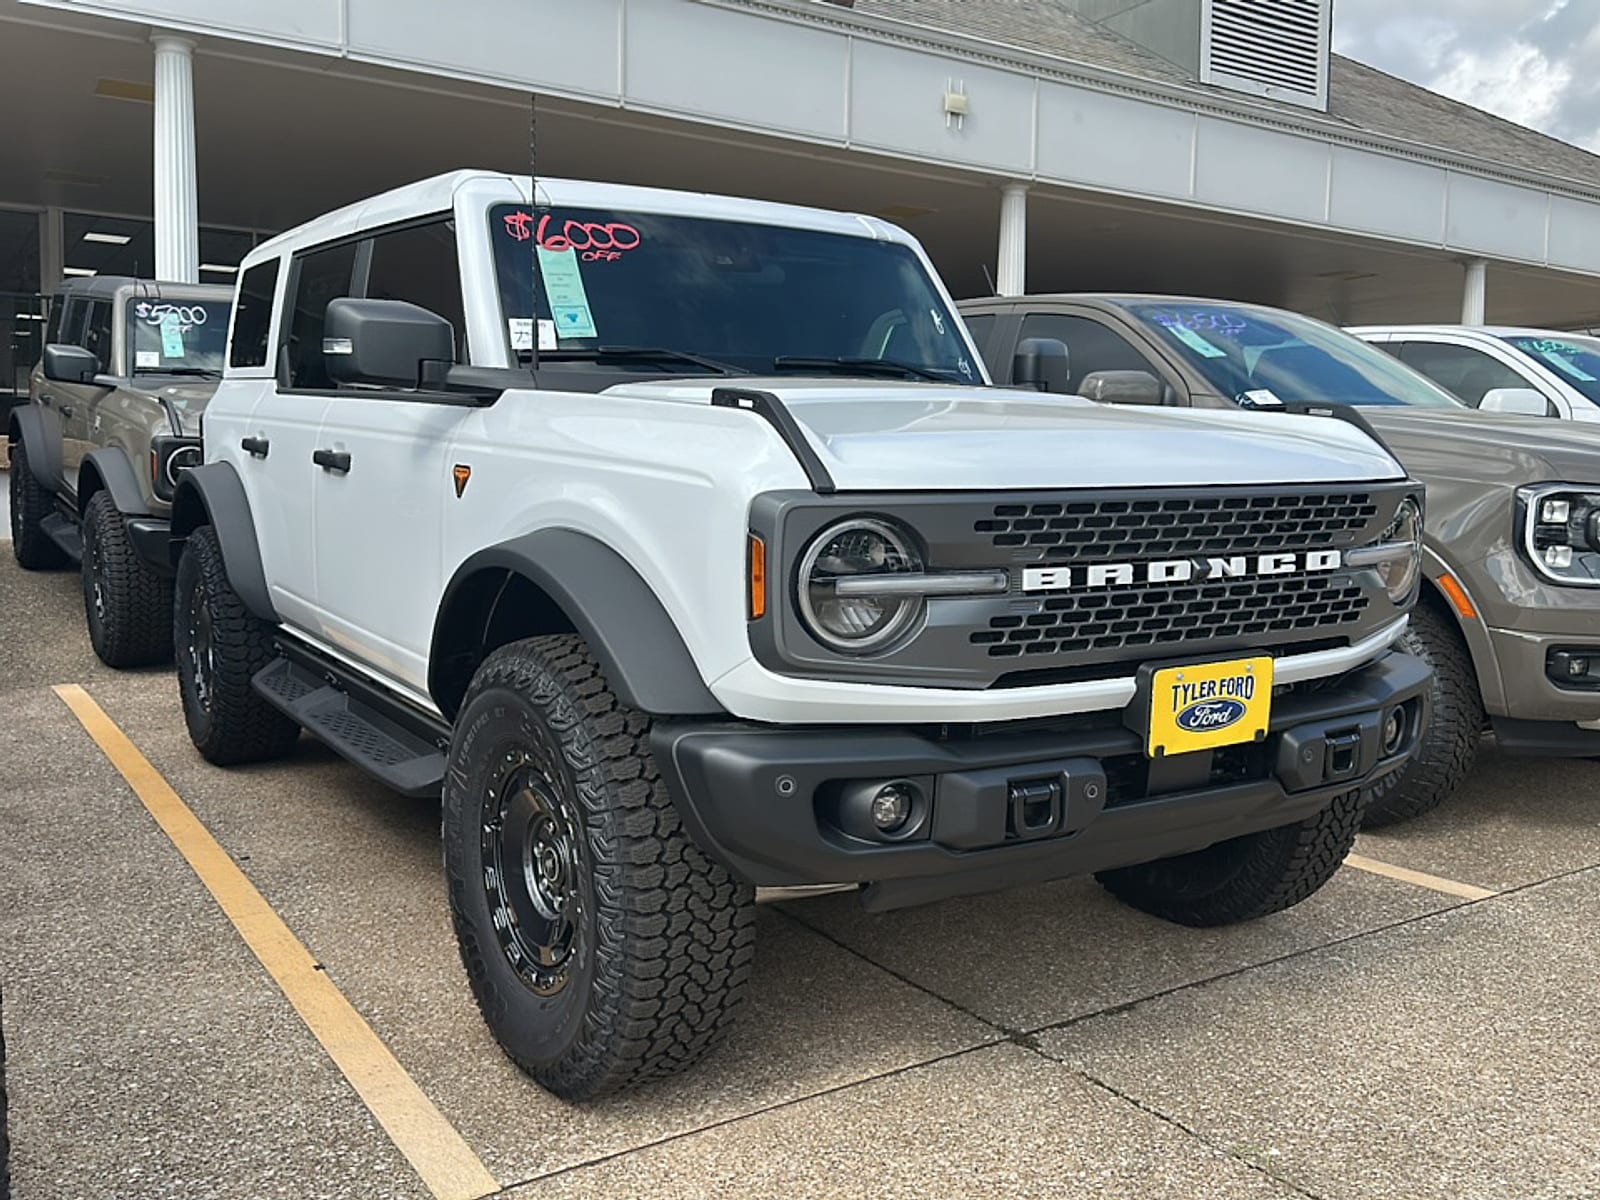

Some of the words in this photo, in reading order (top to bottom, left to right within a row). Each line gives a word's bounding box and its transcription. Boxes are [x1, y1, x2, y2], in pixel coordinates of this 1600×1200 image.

[503, 211, 641, 252] $6000
[135, 302, 207, 325] $5000
[1022, 549, 1342, 591] BRONCO
[1171, 680, 1217, 713] TYLER
[1219, 675, 1255, 701] FORD
[1189, 704, 1233, 727] Ford
